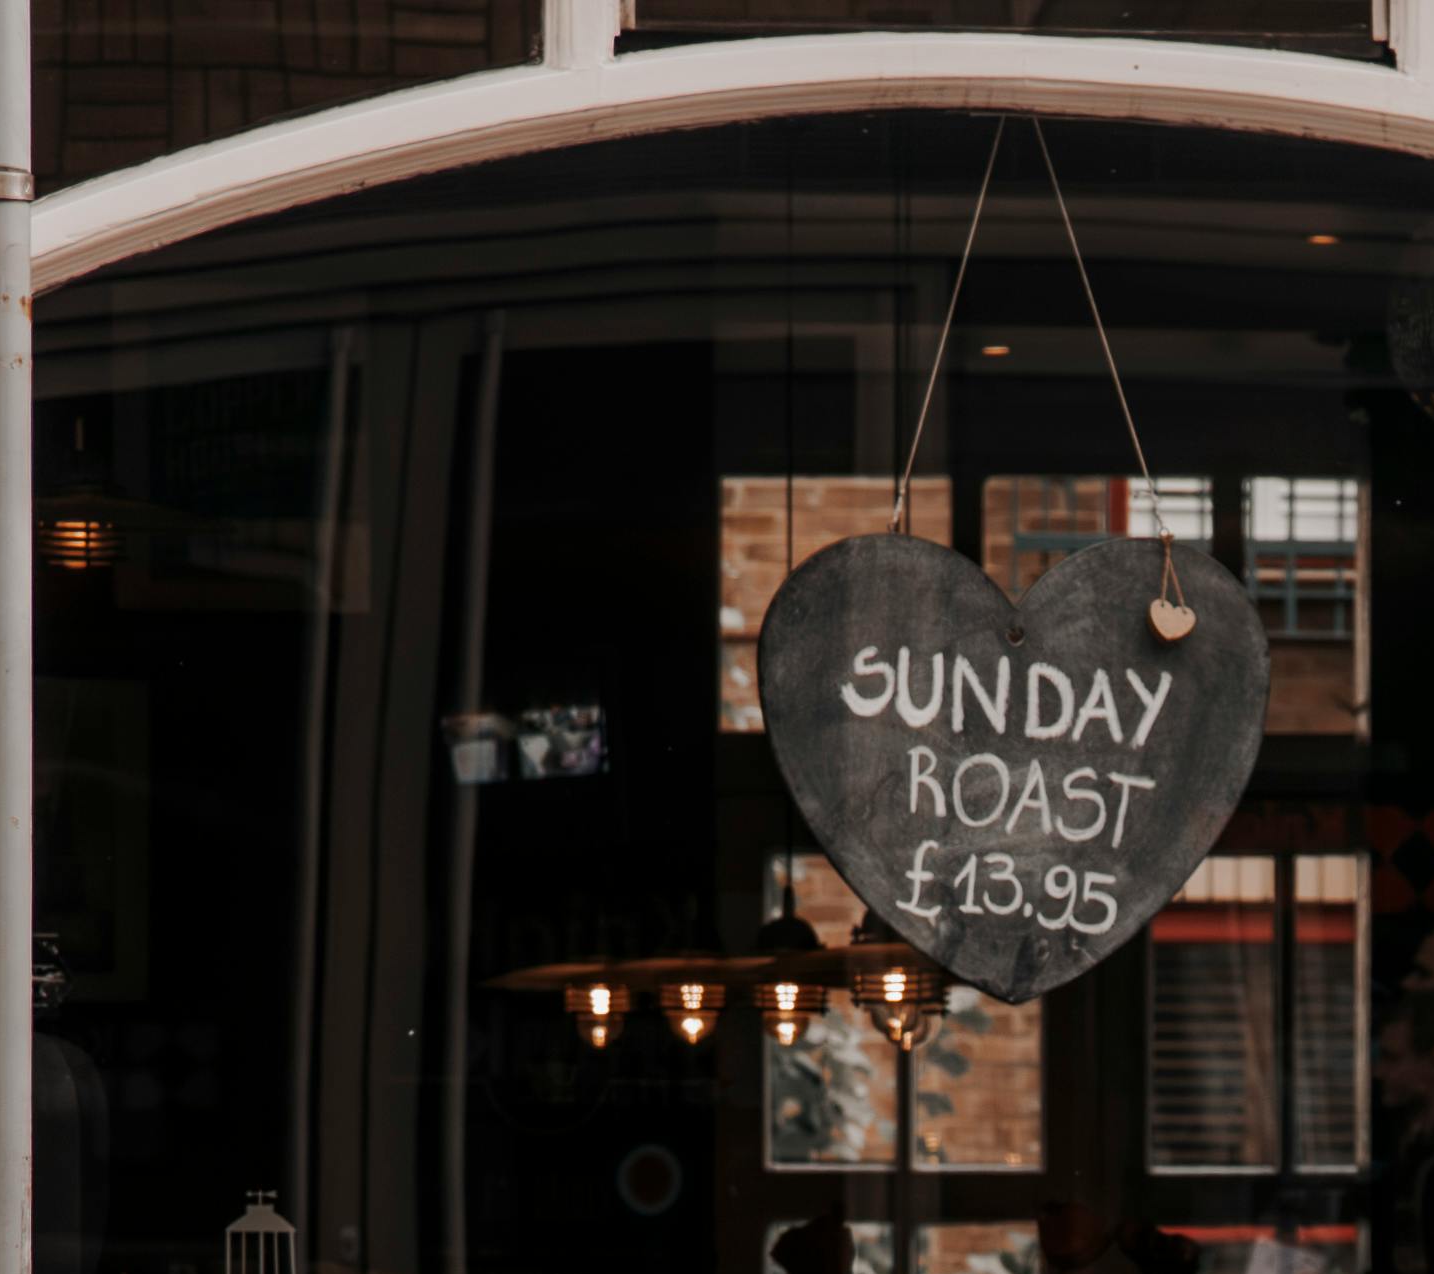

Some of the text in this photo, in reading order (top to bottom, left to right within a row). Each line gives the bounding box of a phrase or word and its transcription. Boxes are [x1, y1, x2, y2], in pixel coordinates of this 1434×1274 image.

[840, 645, 1172, 747] SUNDAY
[907, 746, 1156, 848] ROAST
[896, 840, 1118, 935] £13.95
